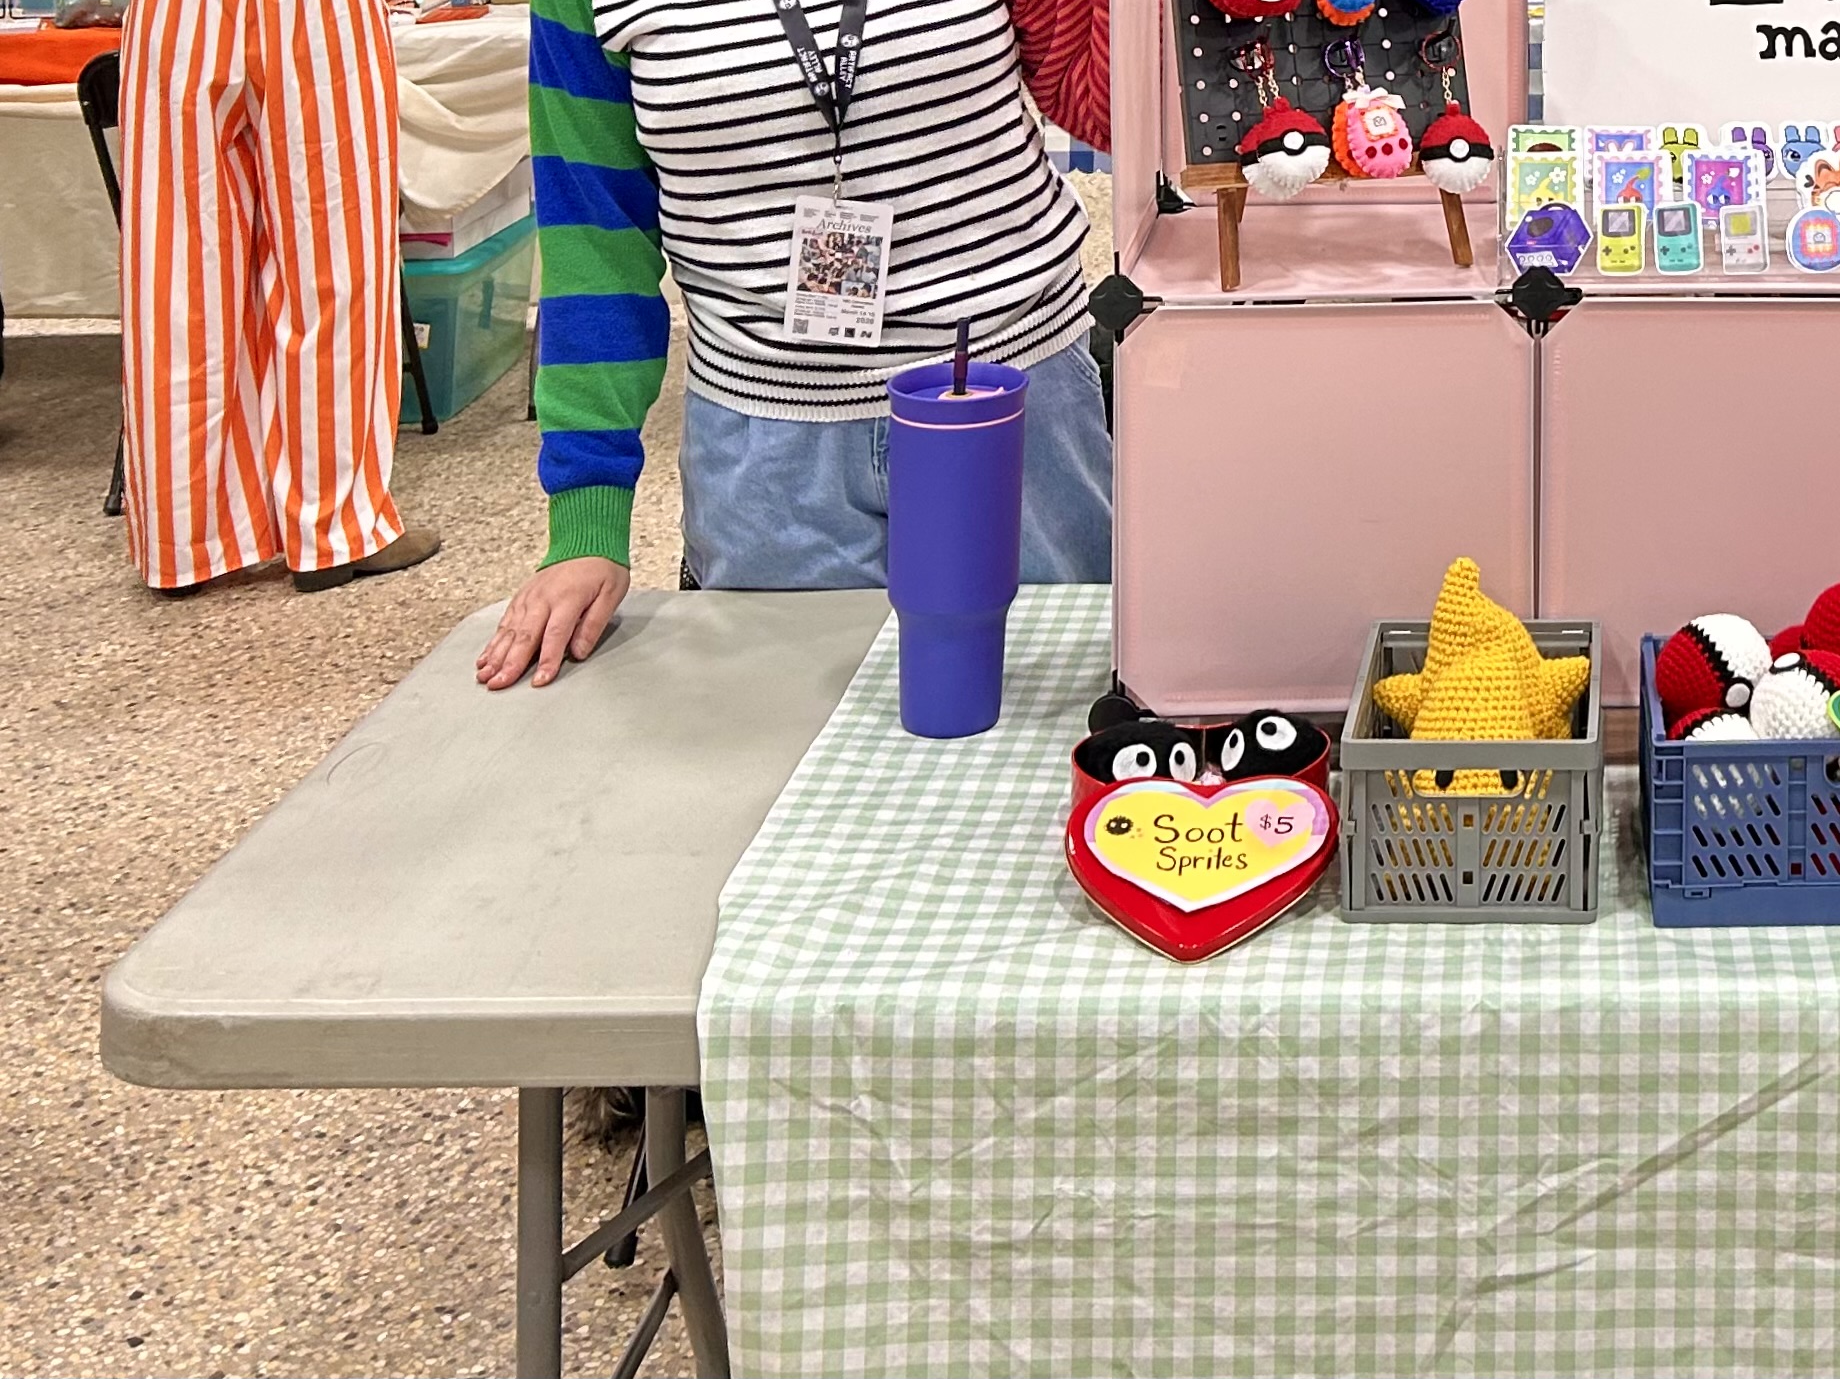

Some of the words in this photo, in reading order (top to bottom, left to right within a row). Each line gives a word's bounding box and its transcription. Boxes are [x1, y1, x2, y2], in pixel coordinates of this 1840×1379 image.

[816, 218, 872, 234] Archives
[1152, 811, 1243, 843] Soot
[1258, 813, 1295, 836] $5
[1155, 846, 1249, 876] Sprites
